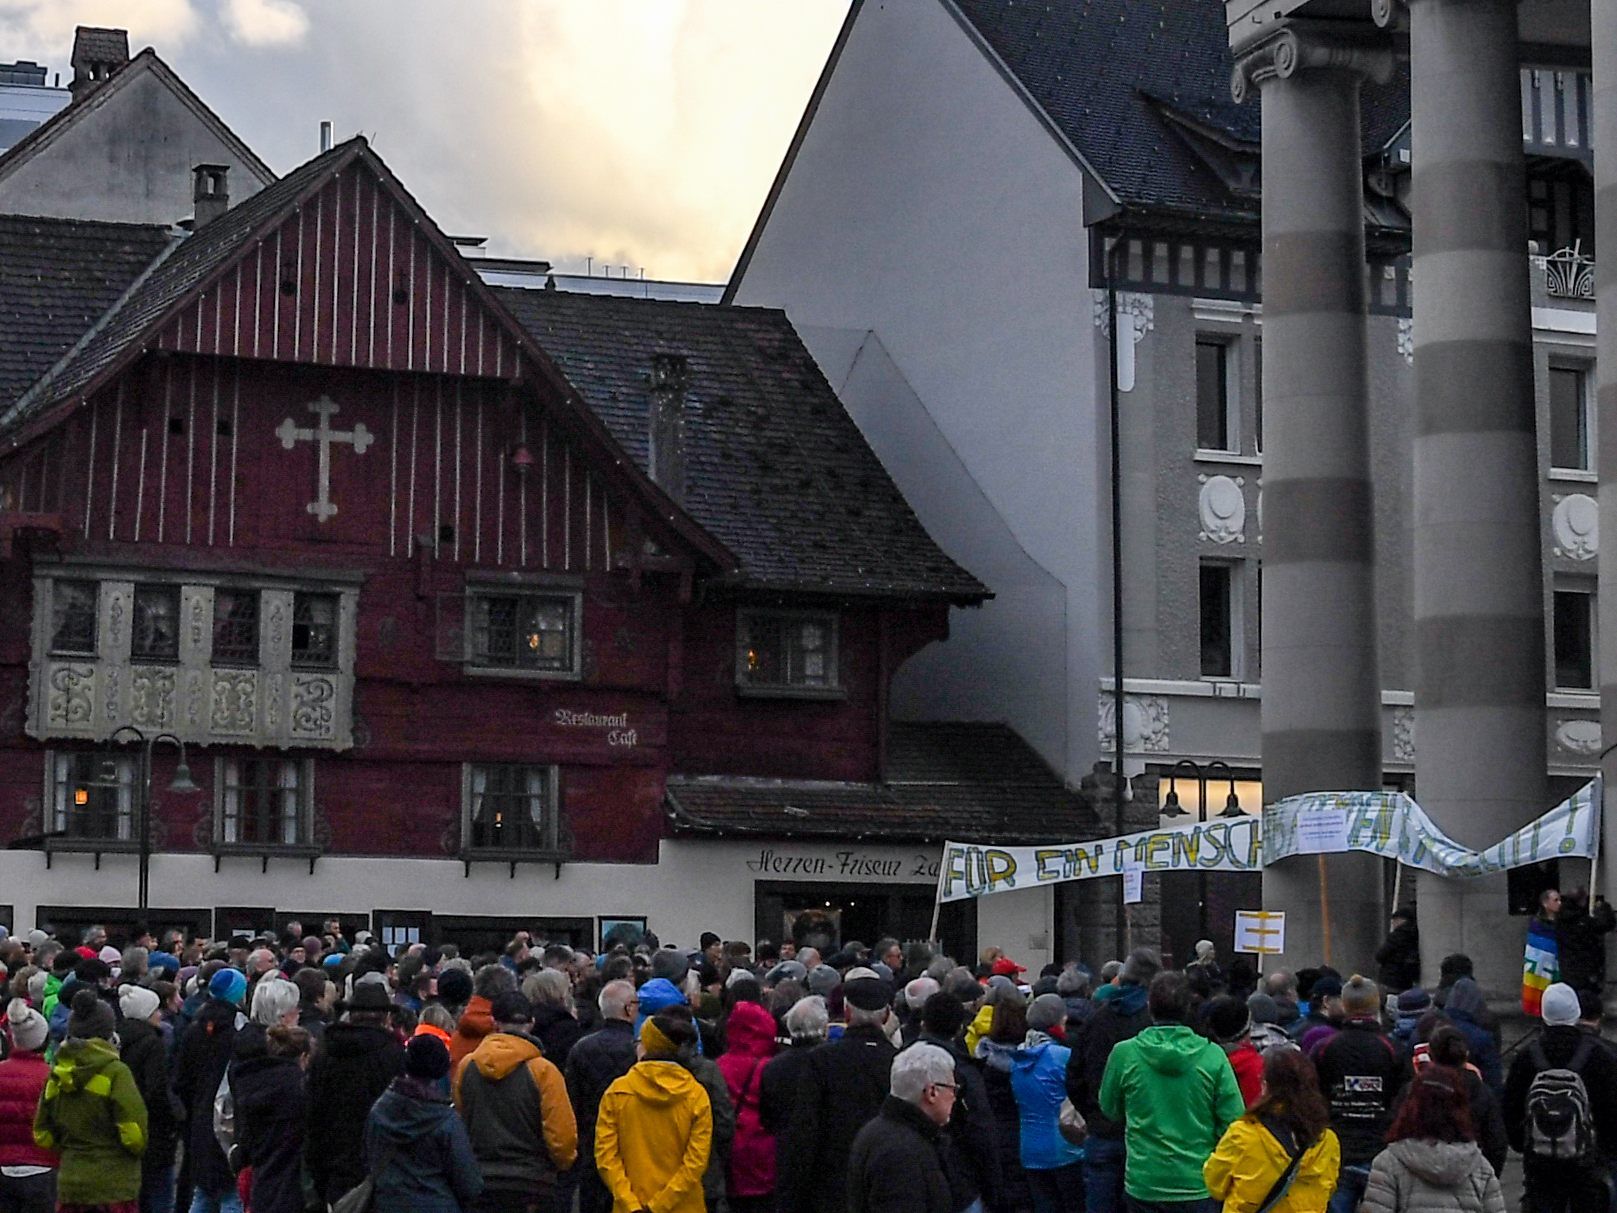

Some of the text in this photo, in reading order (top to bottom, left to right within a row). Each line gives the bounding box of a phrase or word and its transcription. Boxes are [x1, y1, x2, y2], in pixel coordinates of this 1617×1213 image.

[555, 709, 627, 727] Restaurant
[943, 846, 1017, 898] FÜR
[1035, 844, 1103, 882] EIN
